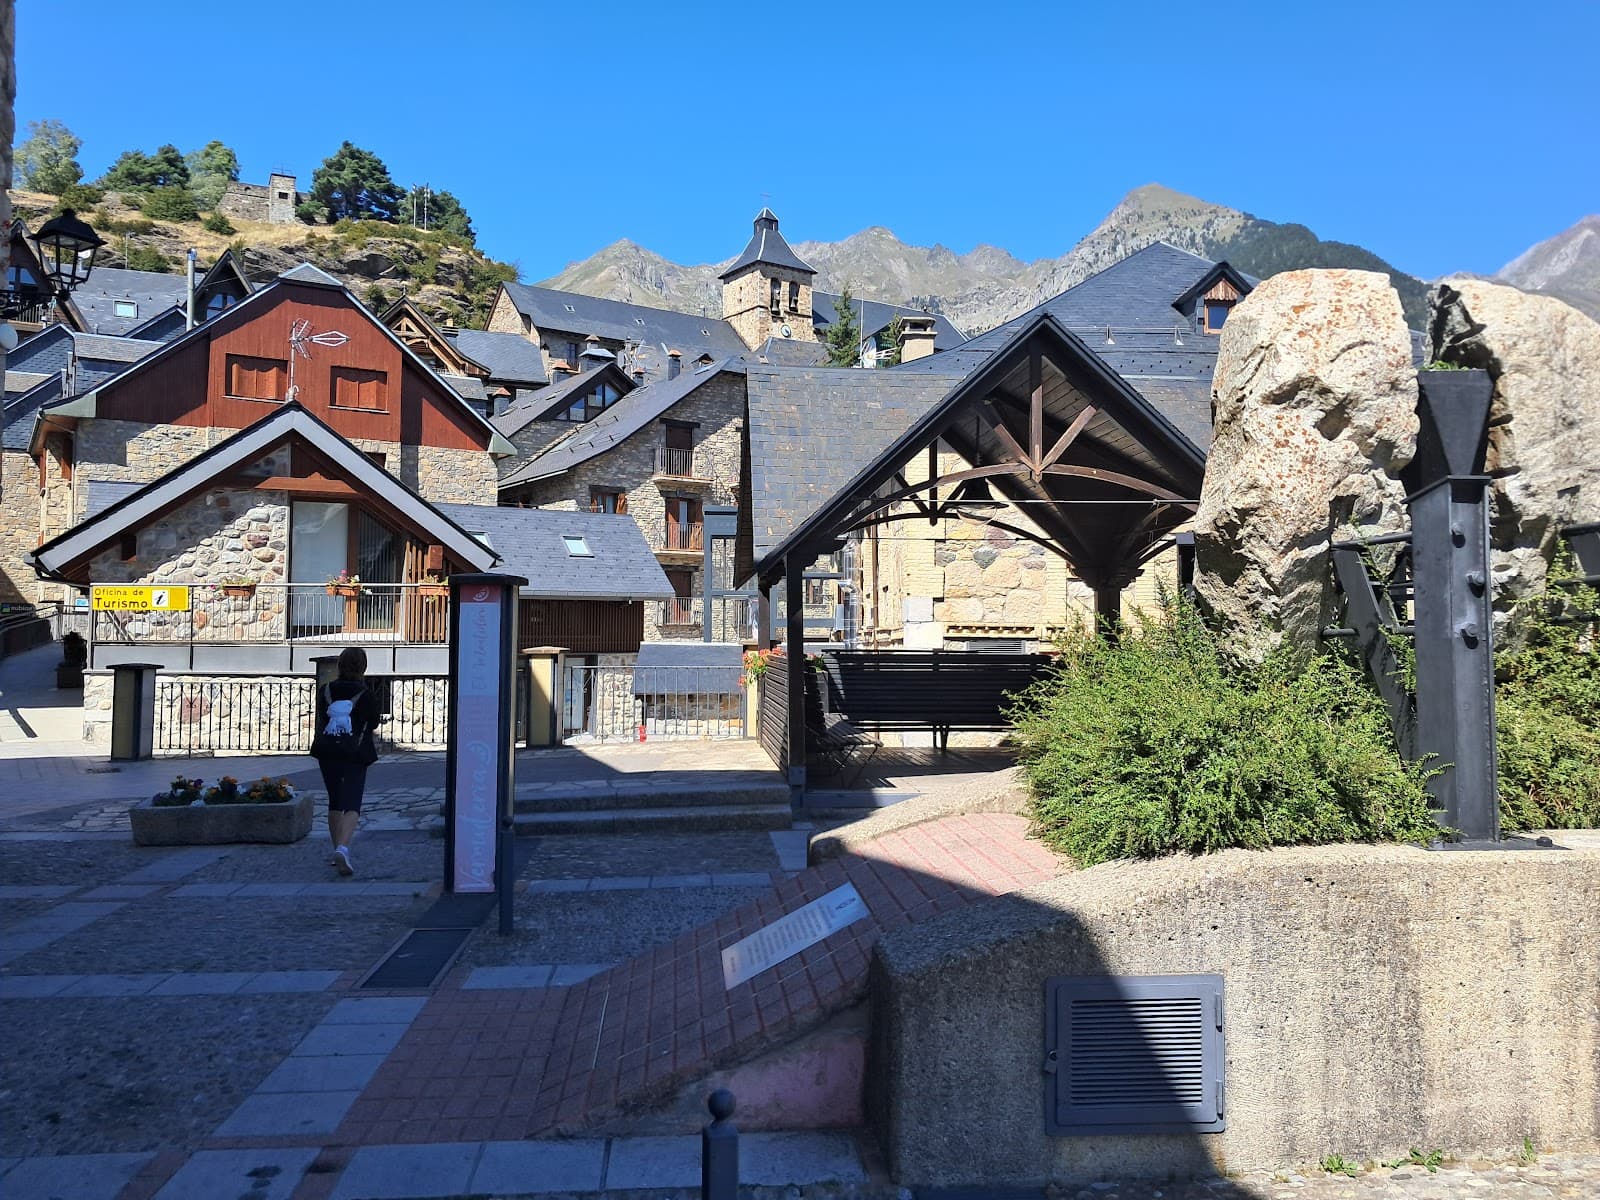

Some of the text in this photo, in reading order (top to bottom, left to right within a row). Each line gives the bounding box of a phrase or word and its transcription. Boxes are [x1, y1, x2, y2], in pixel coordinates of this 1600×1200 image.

[94, 588, 144, 596] Oficina de
[94, 597, 148, 608] Turismo
